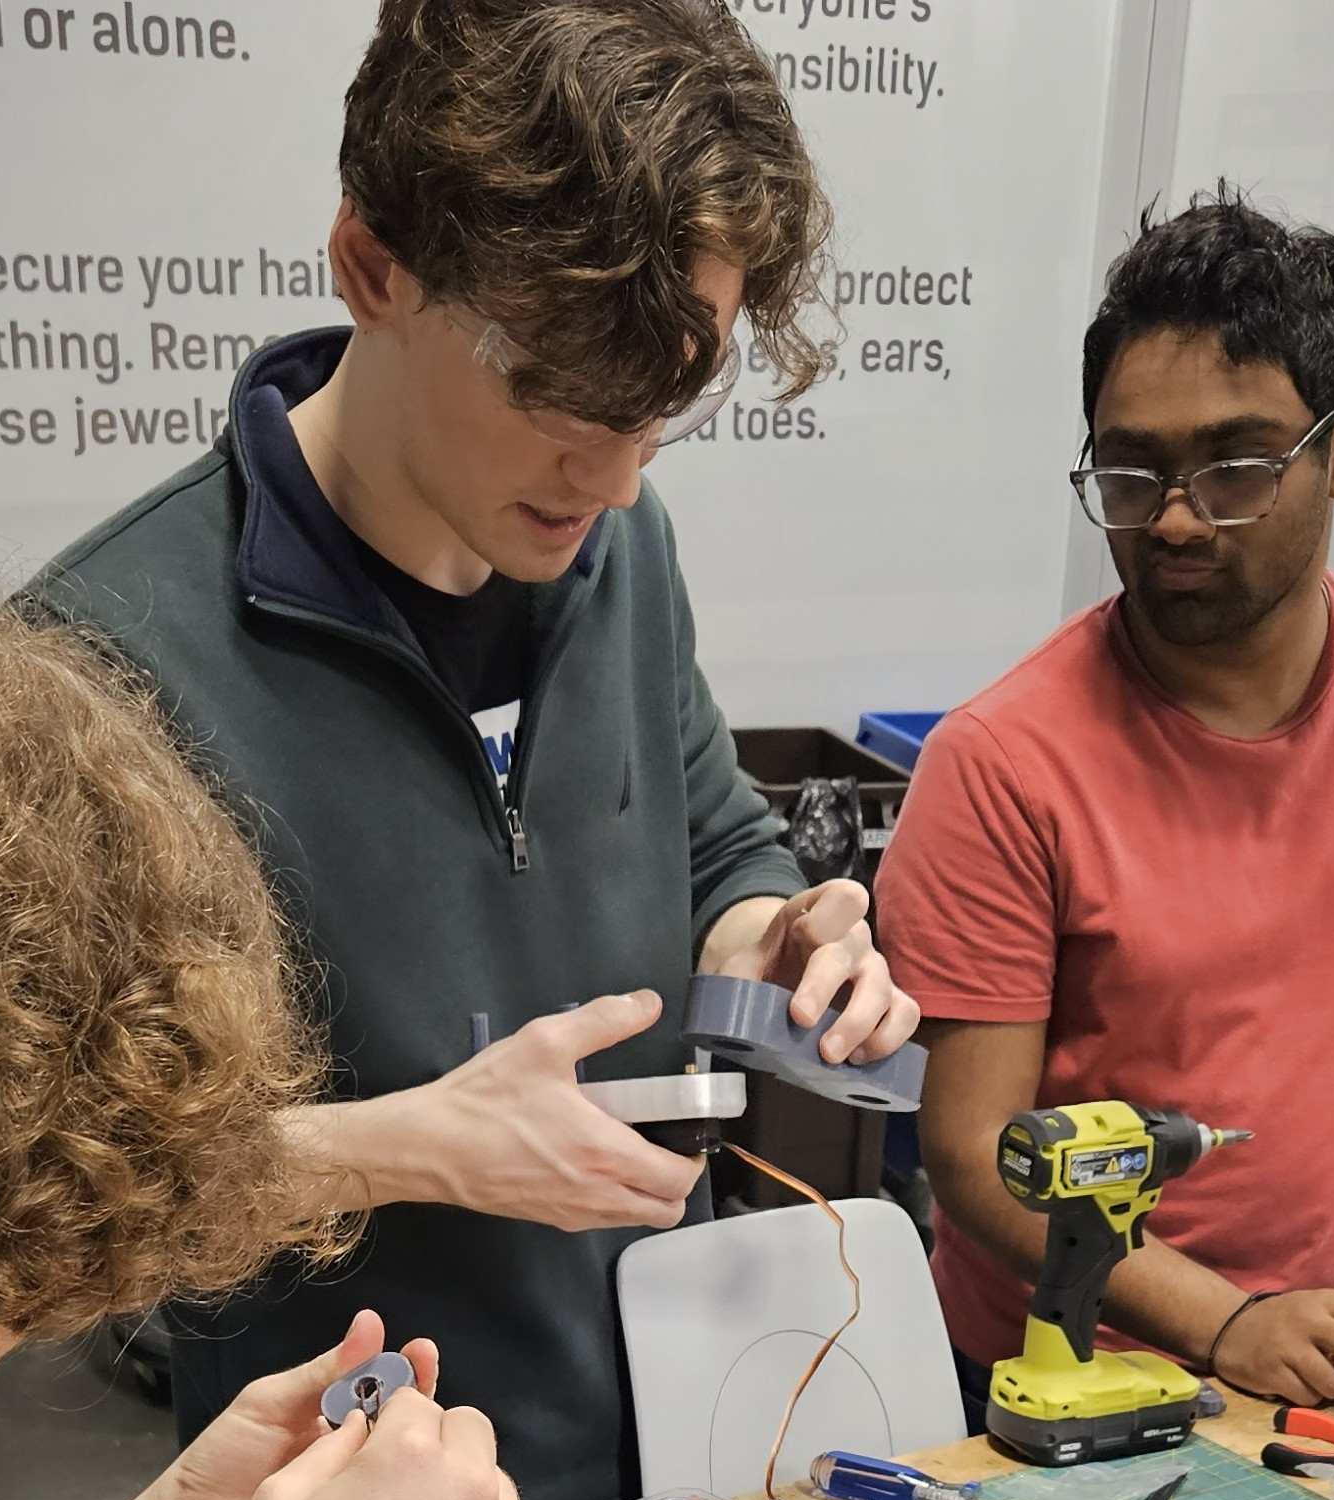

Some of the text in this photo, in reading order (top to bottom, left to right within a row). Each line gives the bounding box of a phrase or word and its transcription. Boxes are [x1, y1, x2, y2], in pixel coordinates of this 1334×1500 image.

[23, 8, 75, 51] or
[92, 0, 251, 61] alone.
[775, 43, 945, 109] nsibility.
[138, 254, 244, 309] your
[834, 265, 974, 307] protect
[151, 321, 278, 372] Rem
[860, 337, 952, 381] ears,
[74, 397, 227, 457] jewelr
[732, 401, 827, 443] toes.
